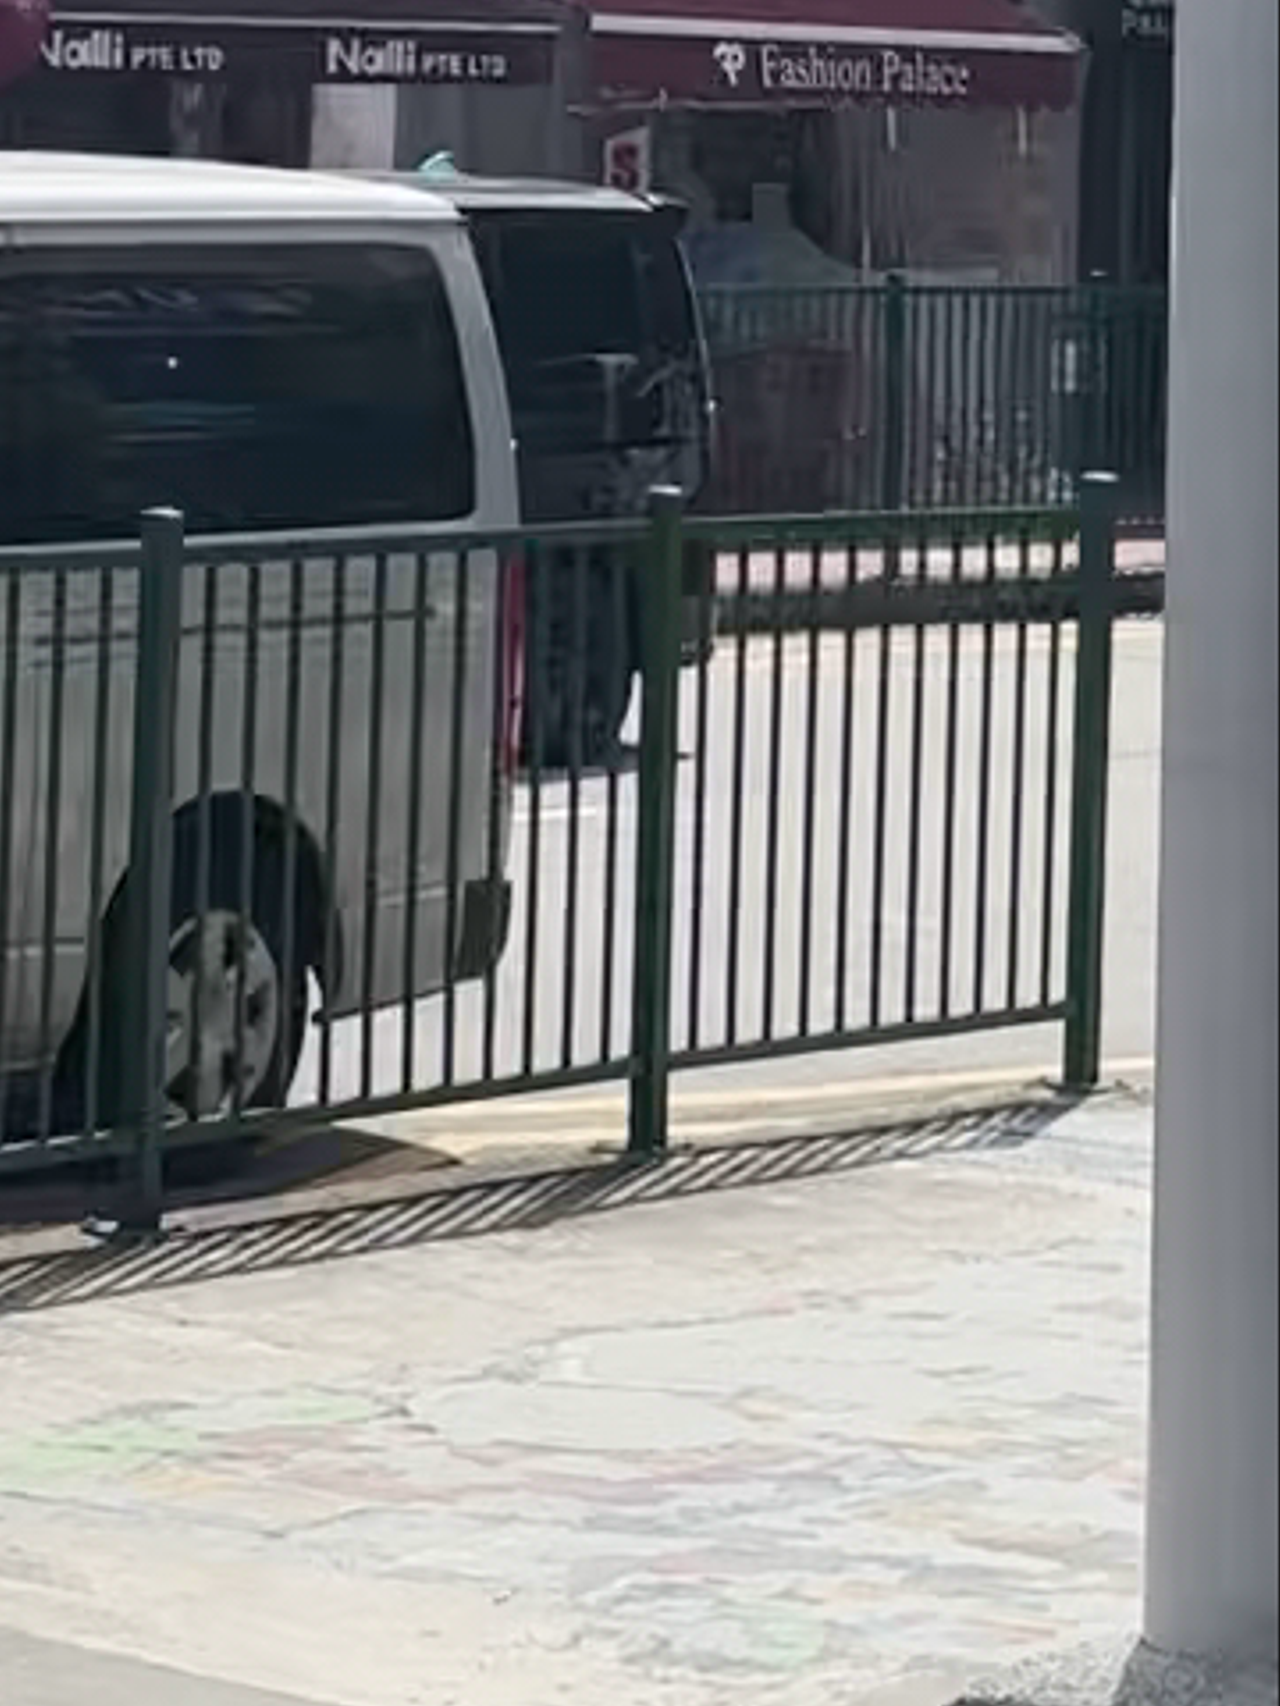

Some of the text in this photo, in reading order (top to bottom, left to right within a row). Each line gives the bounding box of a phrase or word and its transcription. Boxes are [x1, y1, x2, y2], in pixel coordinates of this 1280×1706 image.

[326, 37, 416, 76] Nalli
[761, 43, 969, 95] Fashion Palace
